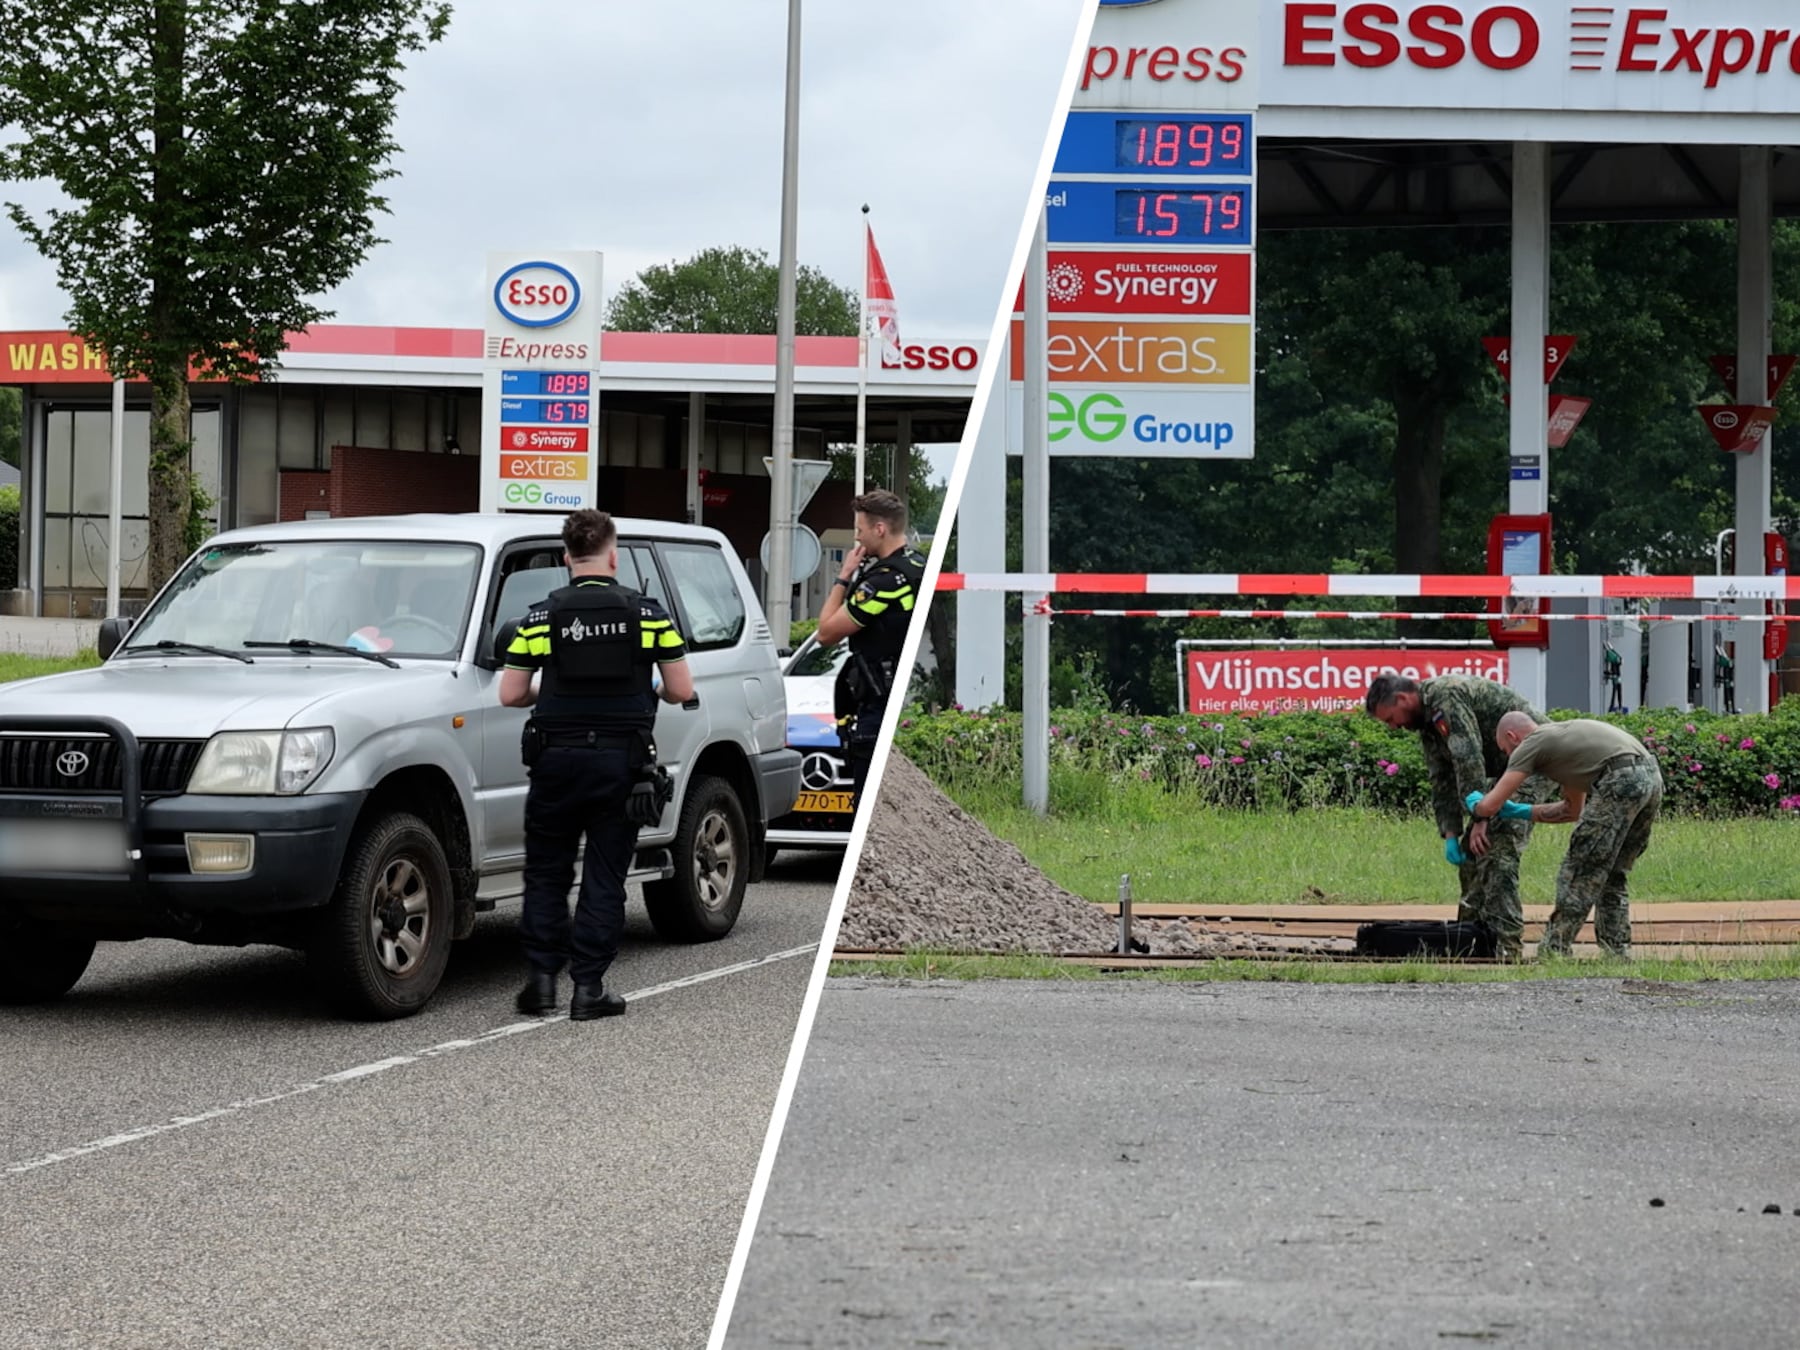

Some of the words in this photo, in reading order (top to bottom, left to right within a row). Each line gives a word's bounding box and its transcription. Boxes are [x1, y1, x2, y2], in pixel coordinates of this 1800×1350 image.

[1284, 3, 1539, 70] ESSO
[1136, 124, 1242, 167] 1.899
[1136, 195, 1241, 236] 1.579
[1116, 263, 1142, 273] FUEL
[1145, 264, 1218, 273] TECHNOLOGY
[508, 279, 568, 305] Esso
[1094, 269, 1218, 304] Synergy
[500, 337, 588, 362] Express
[1048, 326, 1217, 374] extras
[1497, 349, 1509, 364] 4
[1547, 347, 1558, 363] 3
[1726, 366, 1735, 380] 2
[1770, 366, 1778, 381] 1
[547, 375, 588, 394] 1.899
[547, 402, 588, 422] 1.579
[530, 433, 577, 449] Synergy
[1133, 414, 1234, 450] Group
[511, 456, 577, 477] extras
[544, 492, 582, 507] Group
[1199, 699, 1227, 711] Hier
[1230, 698, 1259, 711] elke
